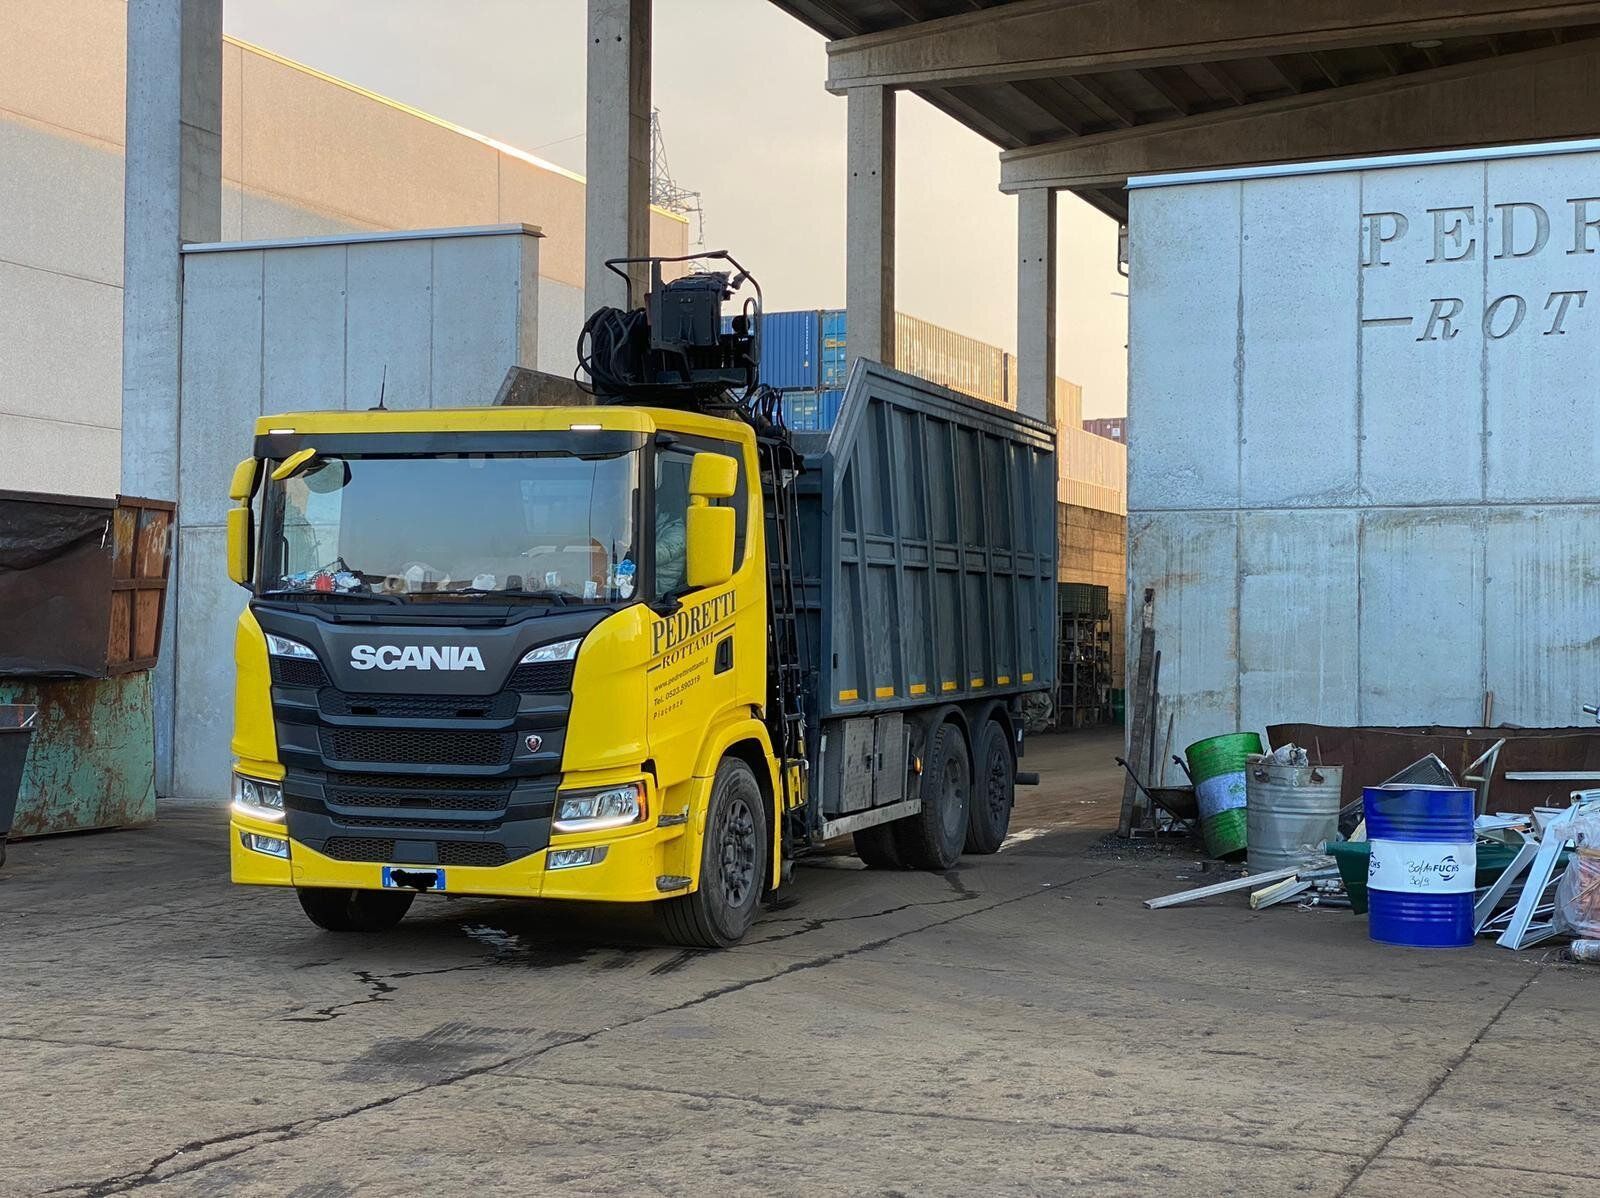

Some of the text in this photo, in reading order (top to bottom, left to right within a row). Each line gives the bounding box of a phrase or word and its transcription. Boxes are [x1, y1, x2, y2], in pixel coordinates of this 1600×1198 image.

[1416, 290, 1588, 342] ROT
[652, 589, 736, 656] PEDRETTI
[350, 644, 486, 671] SCANIA
[661, 631, 715, 669] ROTTAMI
[653, 699, 683, 720] Piacenza
[654, 694, 664, 706] Tel.
[1433, 864, 1459, 872] FUCHS
